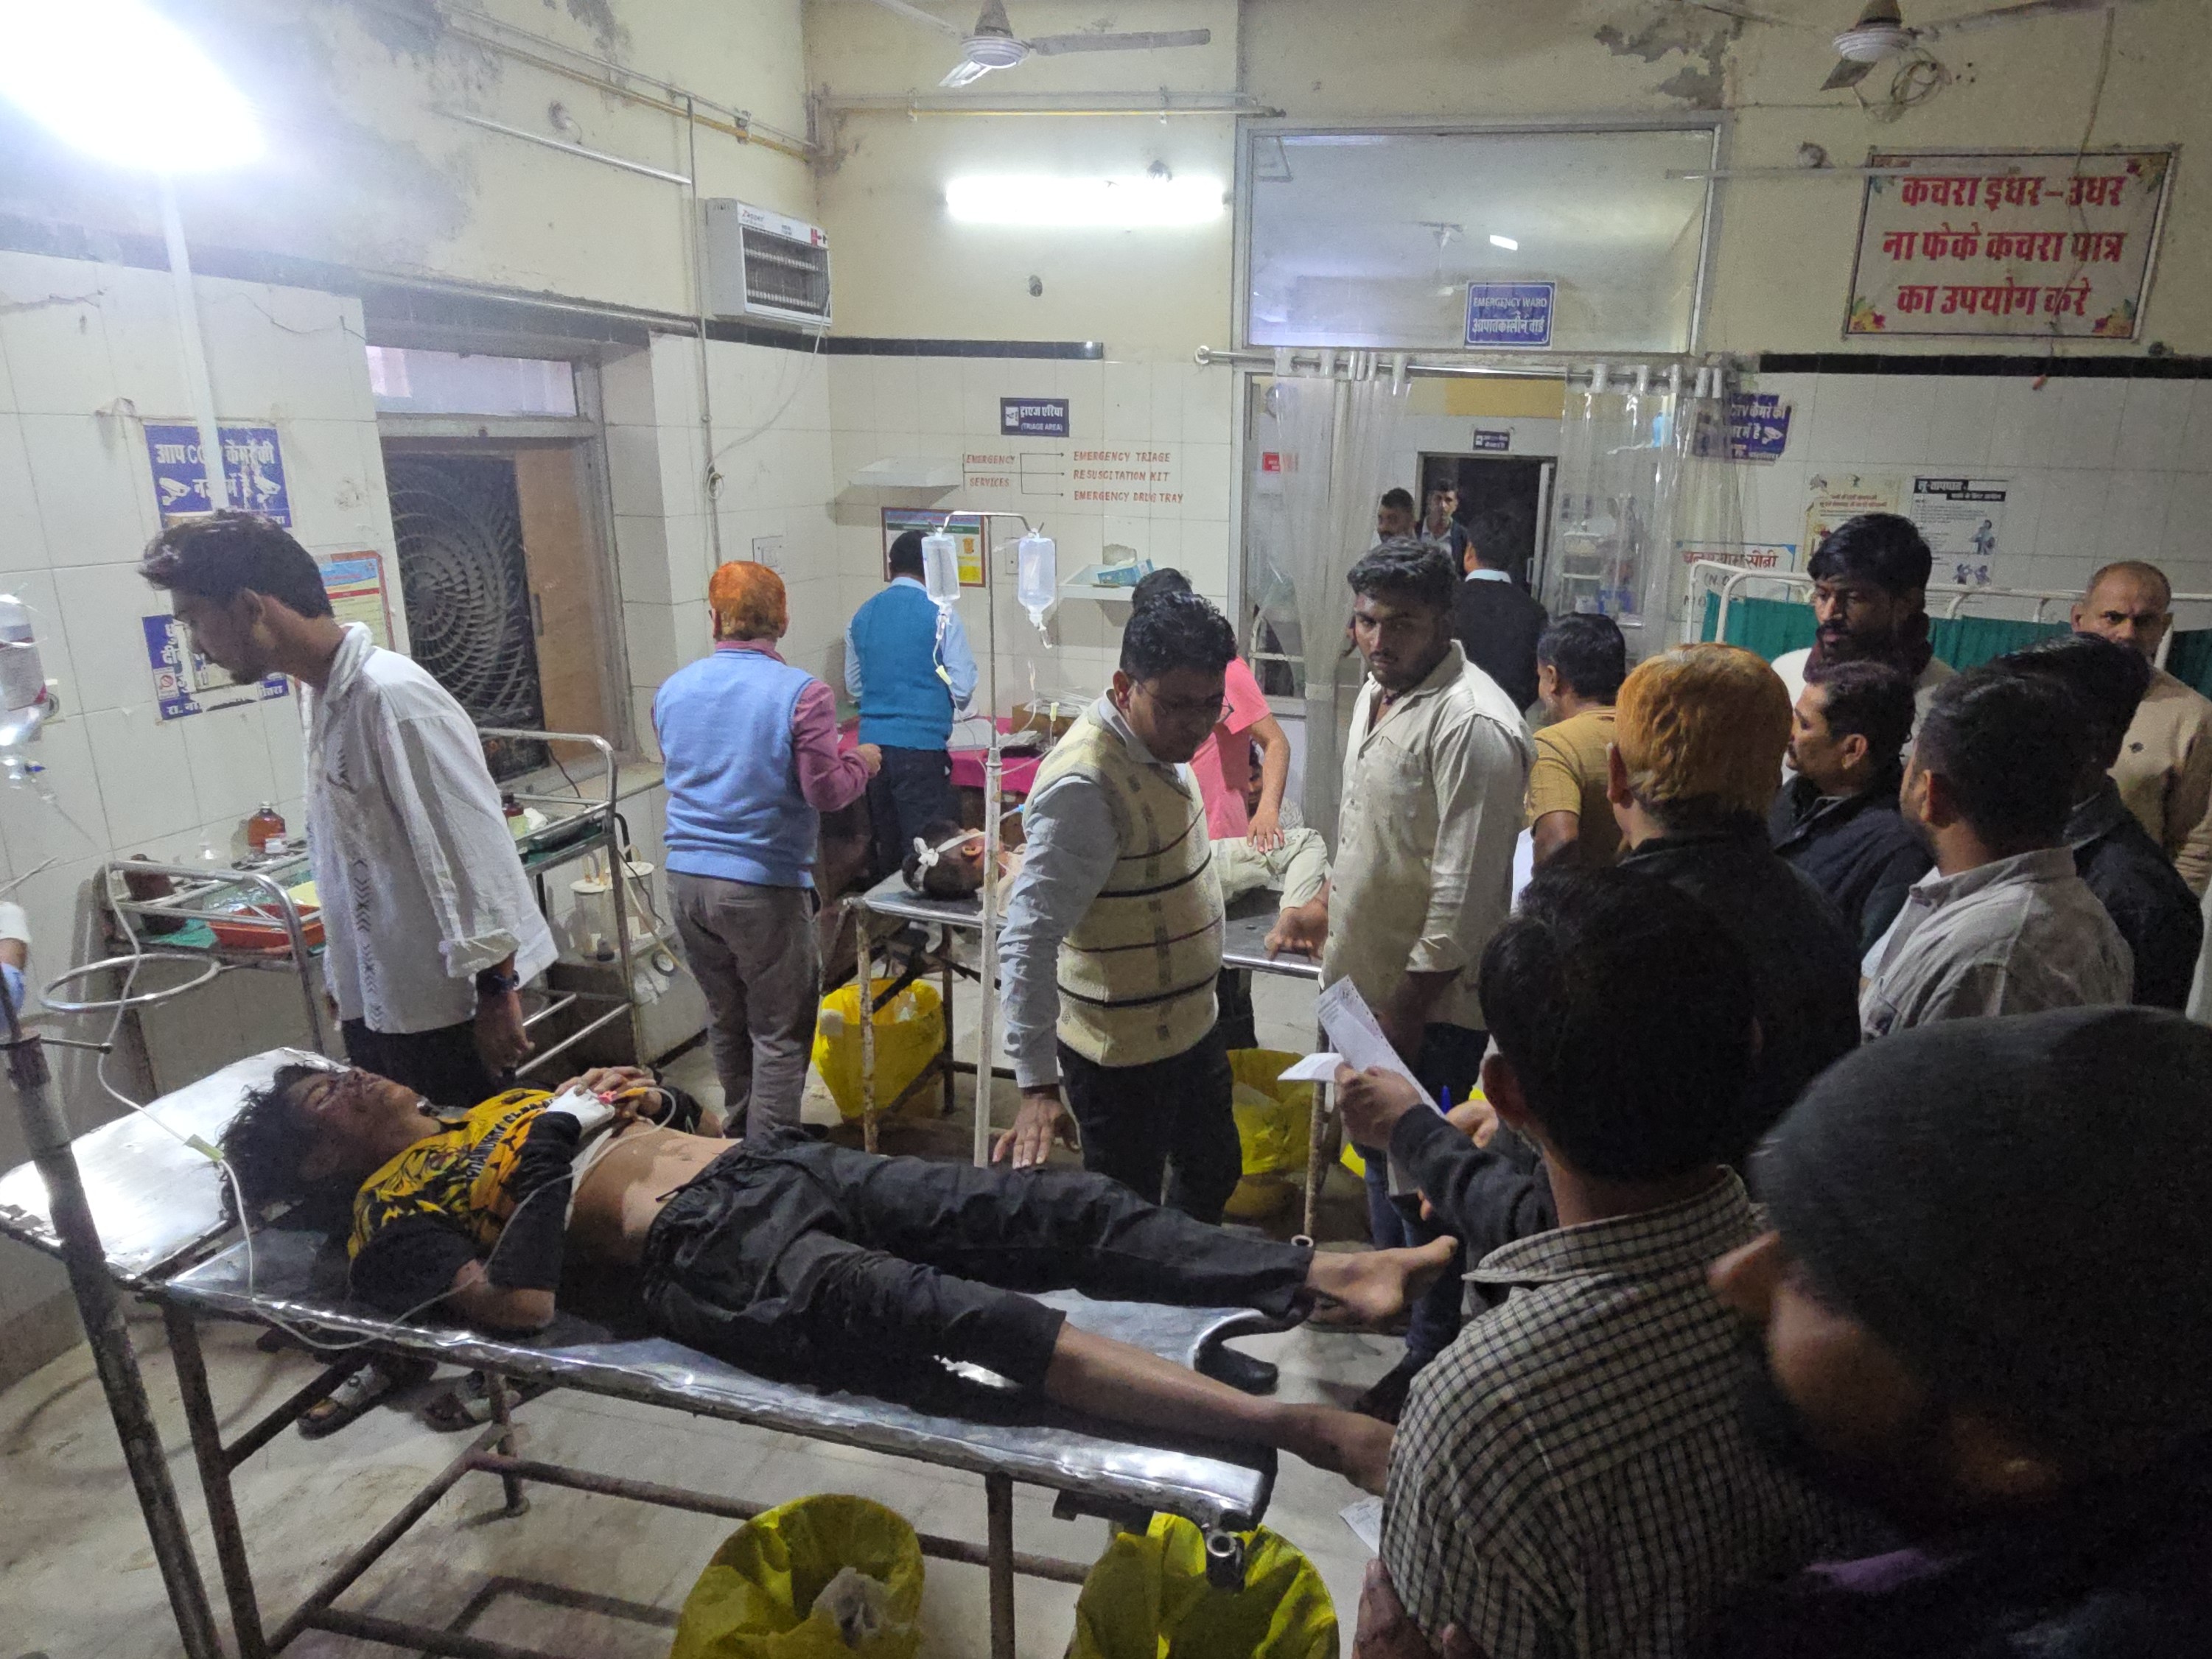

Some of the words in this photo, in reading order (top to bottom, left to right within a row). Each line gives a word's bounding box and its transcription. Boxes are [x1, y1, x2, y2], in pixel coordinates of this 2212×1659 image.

[1902, 176, 1982, 206] कचरा
[1883, 231, 1919, 261] ना
[1922, 222, 1981, 261] फेके
[1985, 231, 2068, 262] कचरा
[2071, 232, 2128, 262] पात्र
[1897, 285, 1939, 314] का
[1940, 276, 2042, 315] उपयोग
[1474, 297, 1521, 309] EMERGENCY
[1522, 297, 1547, 307] WARD
[966, 454, 1015, 465] EMERGENCY
[1074, 451, 1131, 462] EMERGENCY
[1135, 452, 1171, 463] TRIAGE
[1073, 469, 1147, 481] RESUSCITATION
[1149, 471, 1171, 482] KIT
[970, 477, 1009, 488] SERVICES
[1074, 490, 1130, 502] EMERGENCY
[1159, 493, 1183, 504] TRAY
